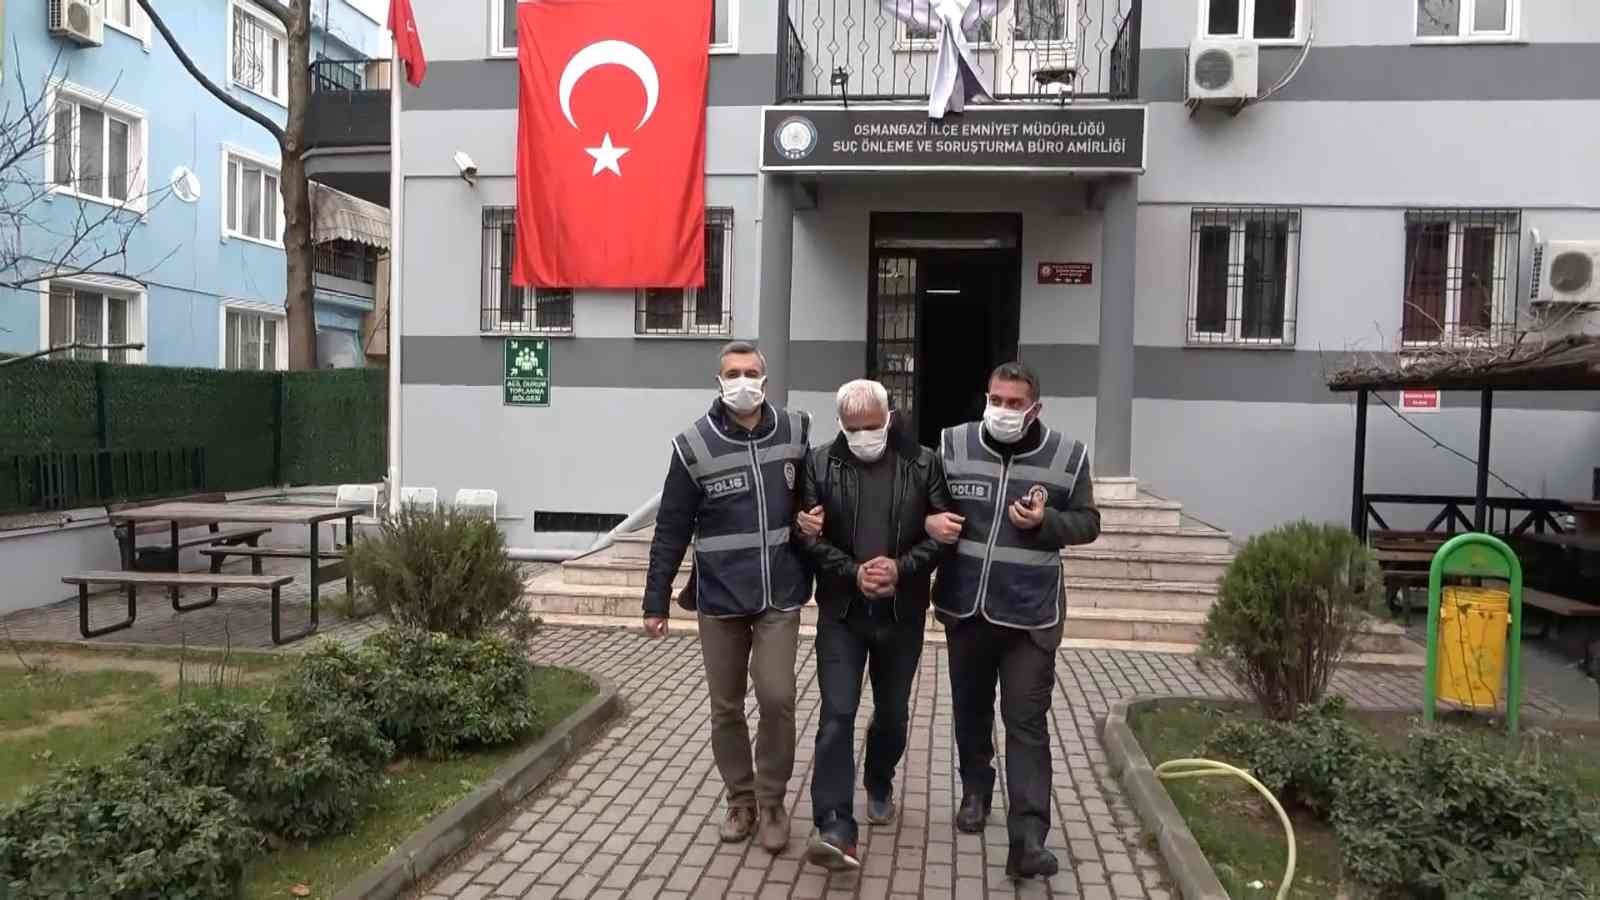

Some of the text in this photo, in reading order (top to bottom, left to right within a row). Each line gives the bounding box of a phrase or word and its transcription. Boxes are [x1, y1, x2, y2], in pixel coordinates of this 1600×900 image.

[854, 121, 1105, 137] OSMANGAZİ İLÇE EMNİYET MÜDÜRLÜĞÜ
[832, 138, 1126, 154] SUÇ ÖNLEME VE SORUŞTURMA BÜRO AMİRLİĞİ
